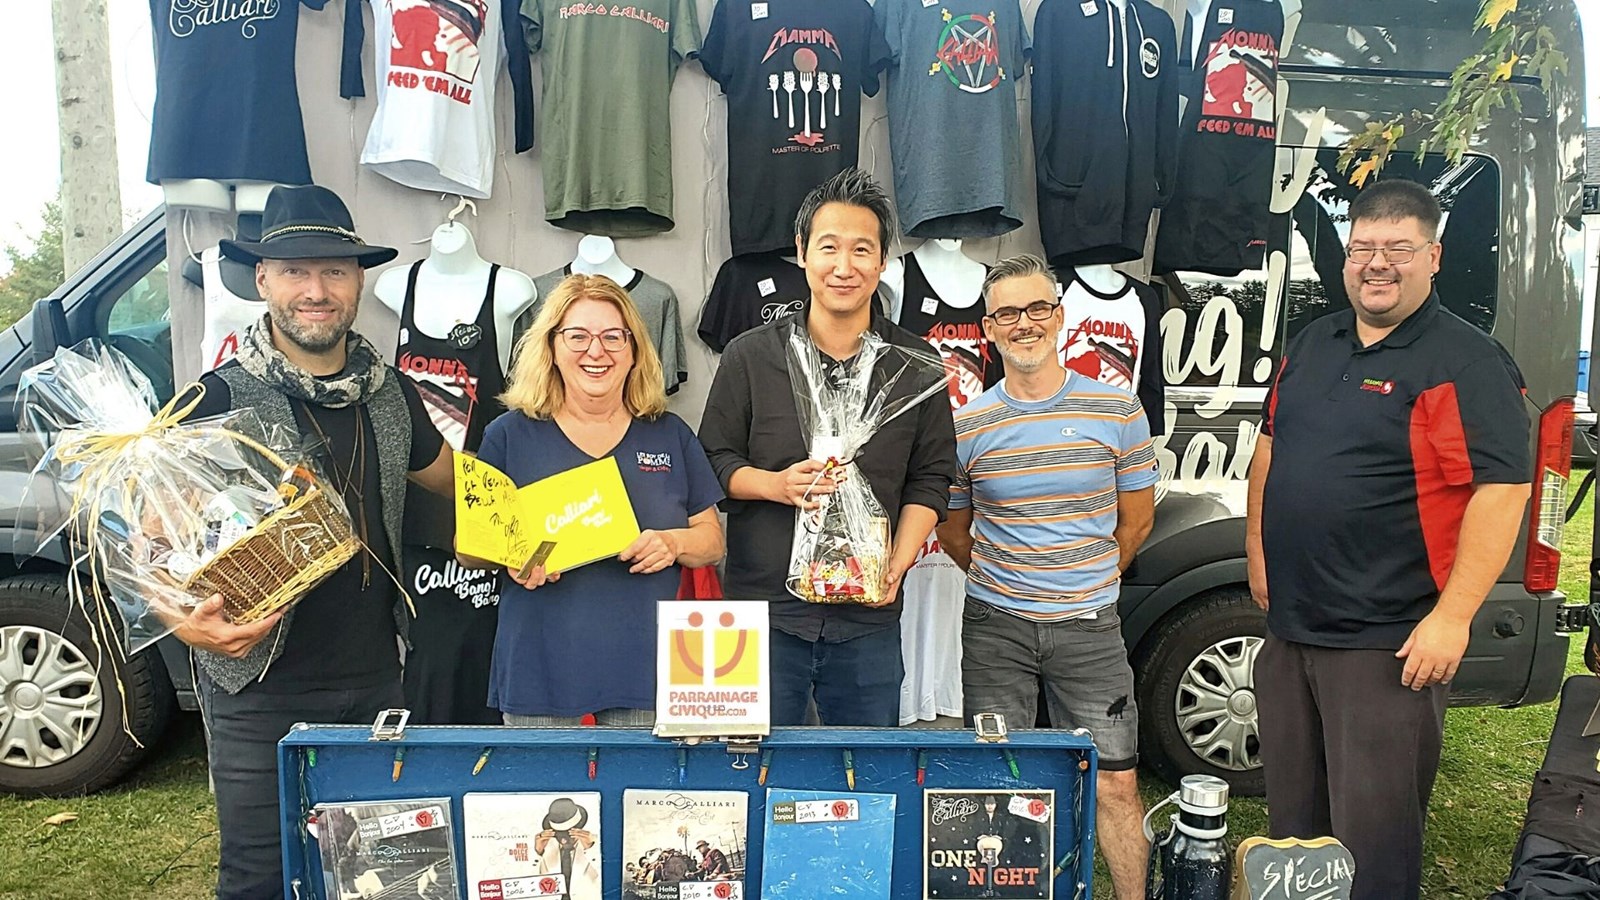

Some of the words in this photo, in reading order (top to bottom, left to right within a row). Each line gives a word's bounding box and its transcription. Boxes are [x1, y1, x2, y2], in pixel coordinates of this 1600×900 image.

[560, 3, 607, 19] MARCO
[610, 5, 669, 33] CALLIARI
[761, 27, 843, 64] MAMMA
[1201, 27, 1279, 70] NONNA
[387, 71, 419, 89] FEED
[450, 83, 472, 105] ALL
[1197, 119, 1230, 133] FEED
[772, 145, 800, 154] MASTER
[921, 321, 992, 363] NONNA
[1059, 315, 1138, 361] NONNA
[399, 350, 478, 404] NONNA
[454, 576, 496, 600] Bang!
[471, 594, 500, 609] Bang
[669, 691, 759, 703] PARRAINAGE
[685, 800, 736, 808] CALLIARI
[1031, 802, 1042, 815] 15
[773, 813, 795, 821] Bonjour
[932, 798, 979, 826] Calliari
[360, 823, 378, 832] Hello
[360, 829, 381, 839] Bonjour
[931, 849, 977, 868] ONE
[480, 884, 500, 892] Hello
[480, 891, 501, 899] Bonjour
